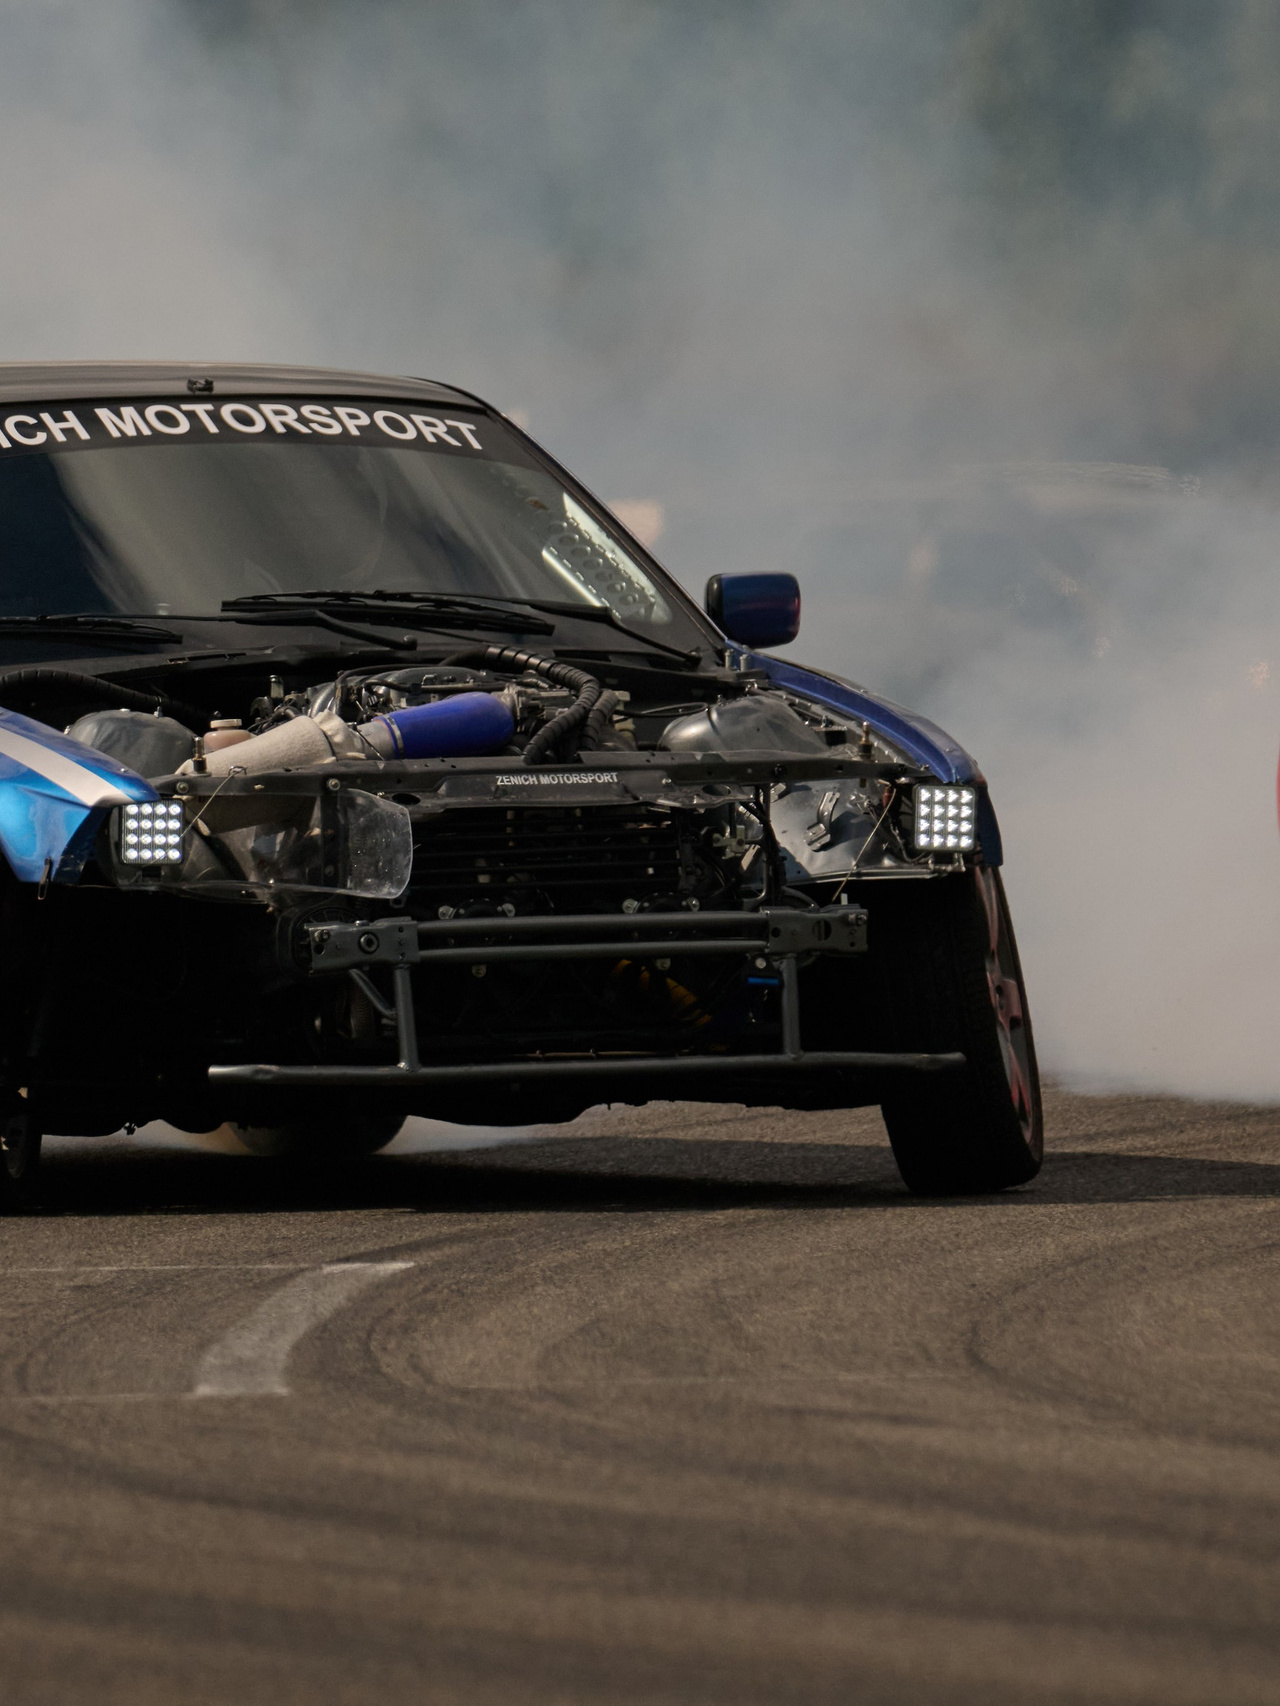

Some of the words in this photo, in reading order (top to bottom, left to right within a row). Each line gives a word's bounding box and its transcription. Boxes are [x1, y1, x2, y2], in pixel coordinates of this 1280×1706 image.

[94, 403, 483, 450] MOTORSPORT
[496, 774, 539, 785] ZENICH
[540, 772, 618, 784] MOTORSPORT
